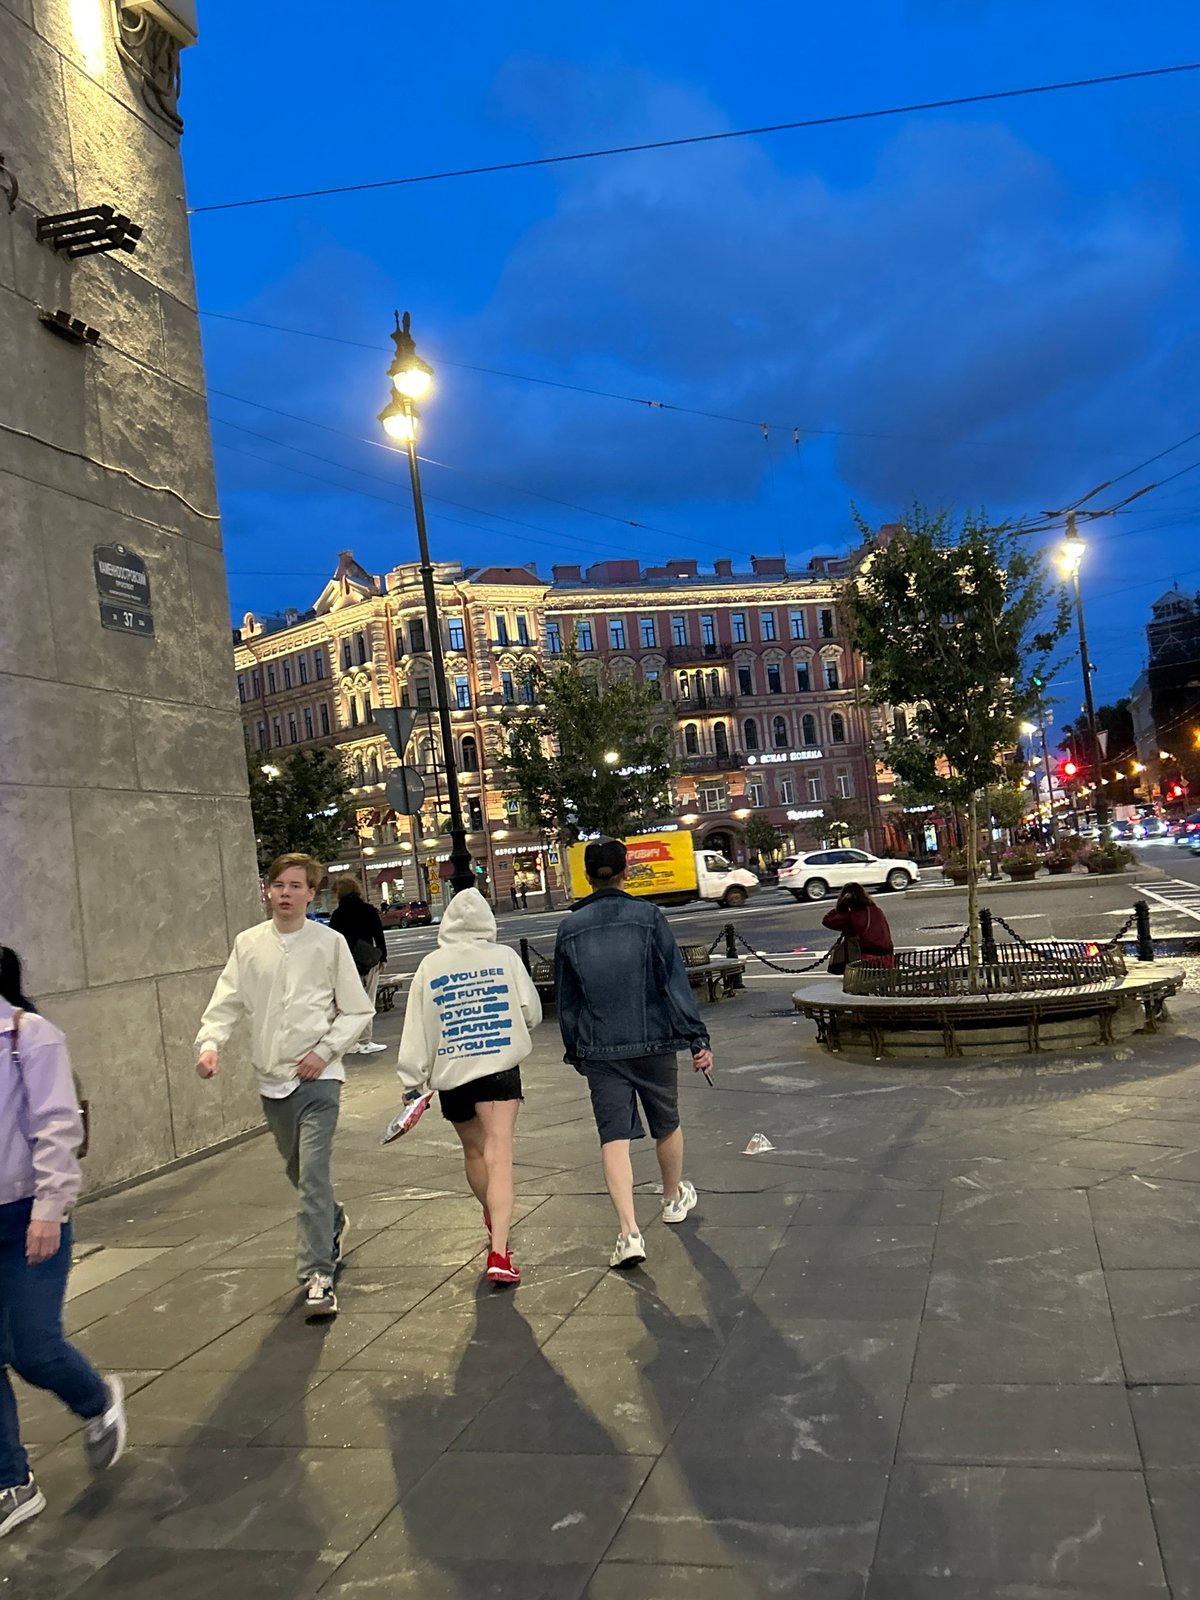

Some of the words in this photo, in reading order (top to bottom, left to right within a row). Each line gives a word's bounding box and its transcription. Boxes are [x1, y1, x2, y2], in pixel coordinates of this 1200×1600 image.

[123, 611, 133, 628] 37
[450, 971, 478, 983] YOU
[479, 967, 505, 978] SEE
[457, 984, 509, 999] FUTURE
[454, 1005, 482, 1018] YOU
[460, 1018, 512, 1034] FUTURE
[437, 1046, 455, 1056] DO
[456, 1040, 484, 1052] YOU
